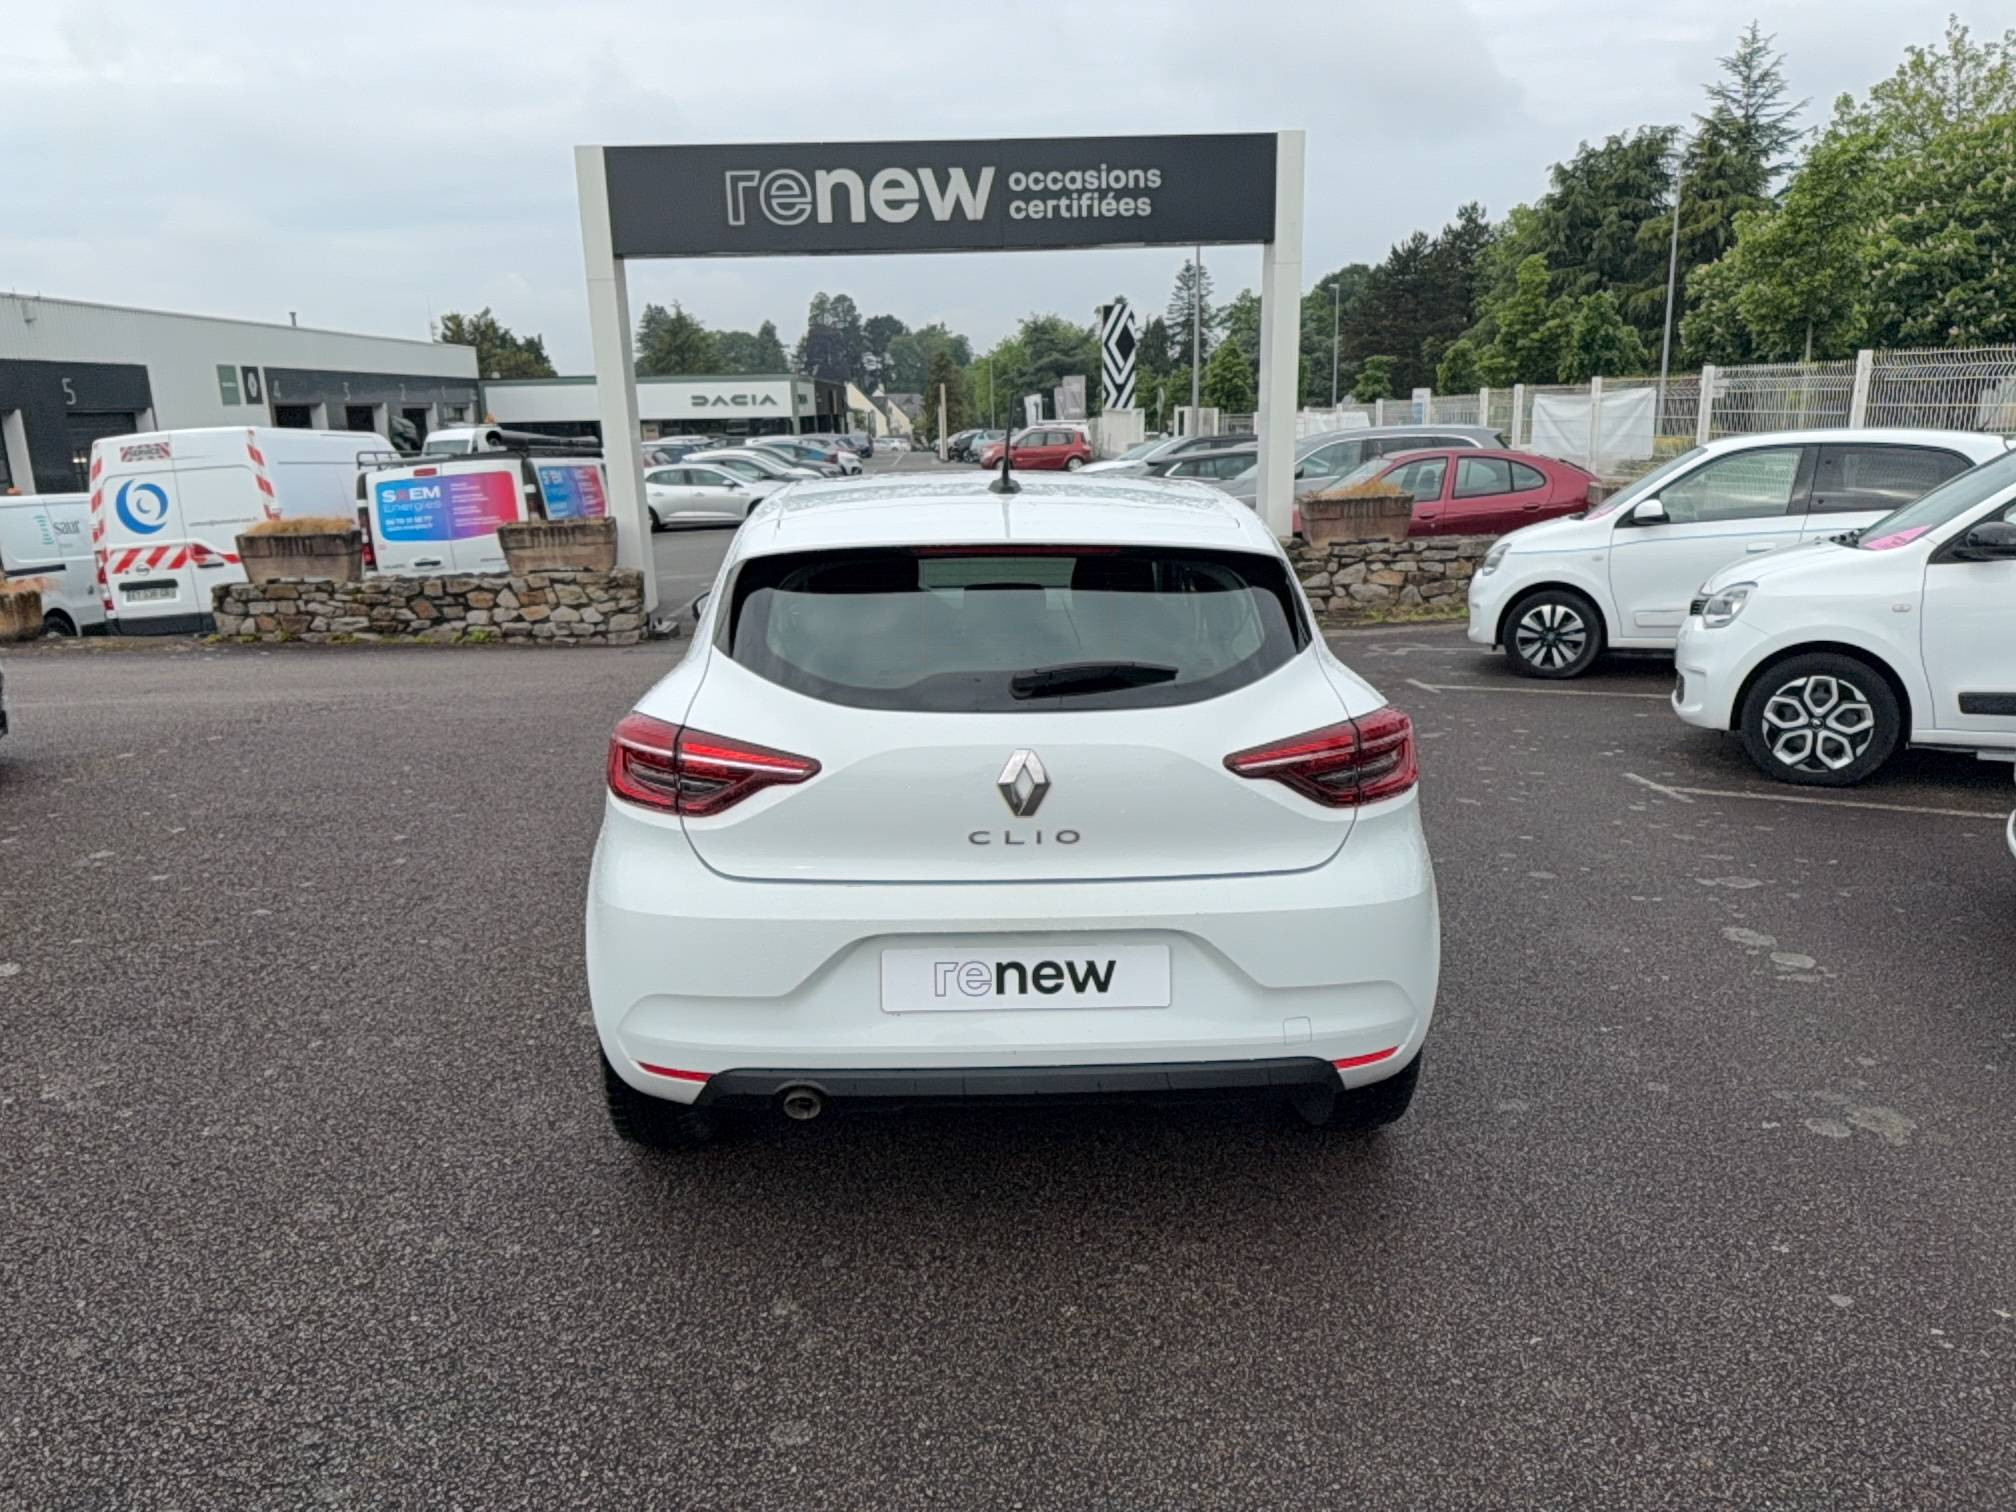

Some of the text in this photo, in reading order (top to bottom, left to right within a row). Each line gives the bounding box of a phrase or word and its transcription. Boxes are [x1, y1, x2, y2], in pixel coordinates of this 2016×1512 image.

[1008, 164, 1162, 191] occasions
[725, 165, 996, 226] renew
[1008, 192, 1152, 220] certifiées
[62, 377, 77, 405] 5
[690, 393, 778, 407] DACIA
[968, 830, 1080, 845] CLIO
[934, 960, 1117, 997] renew
